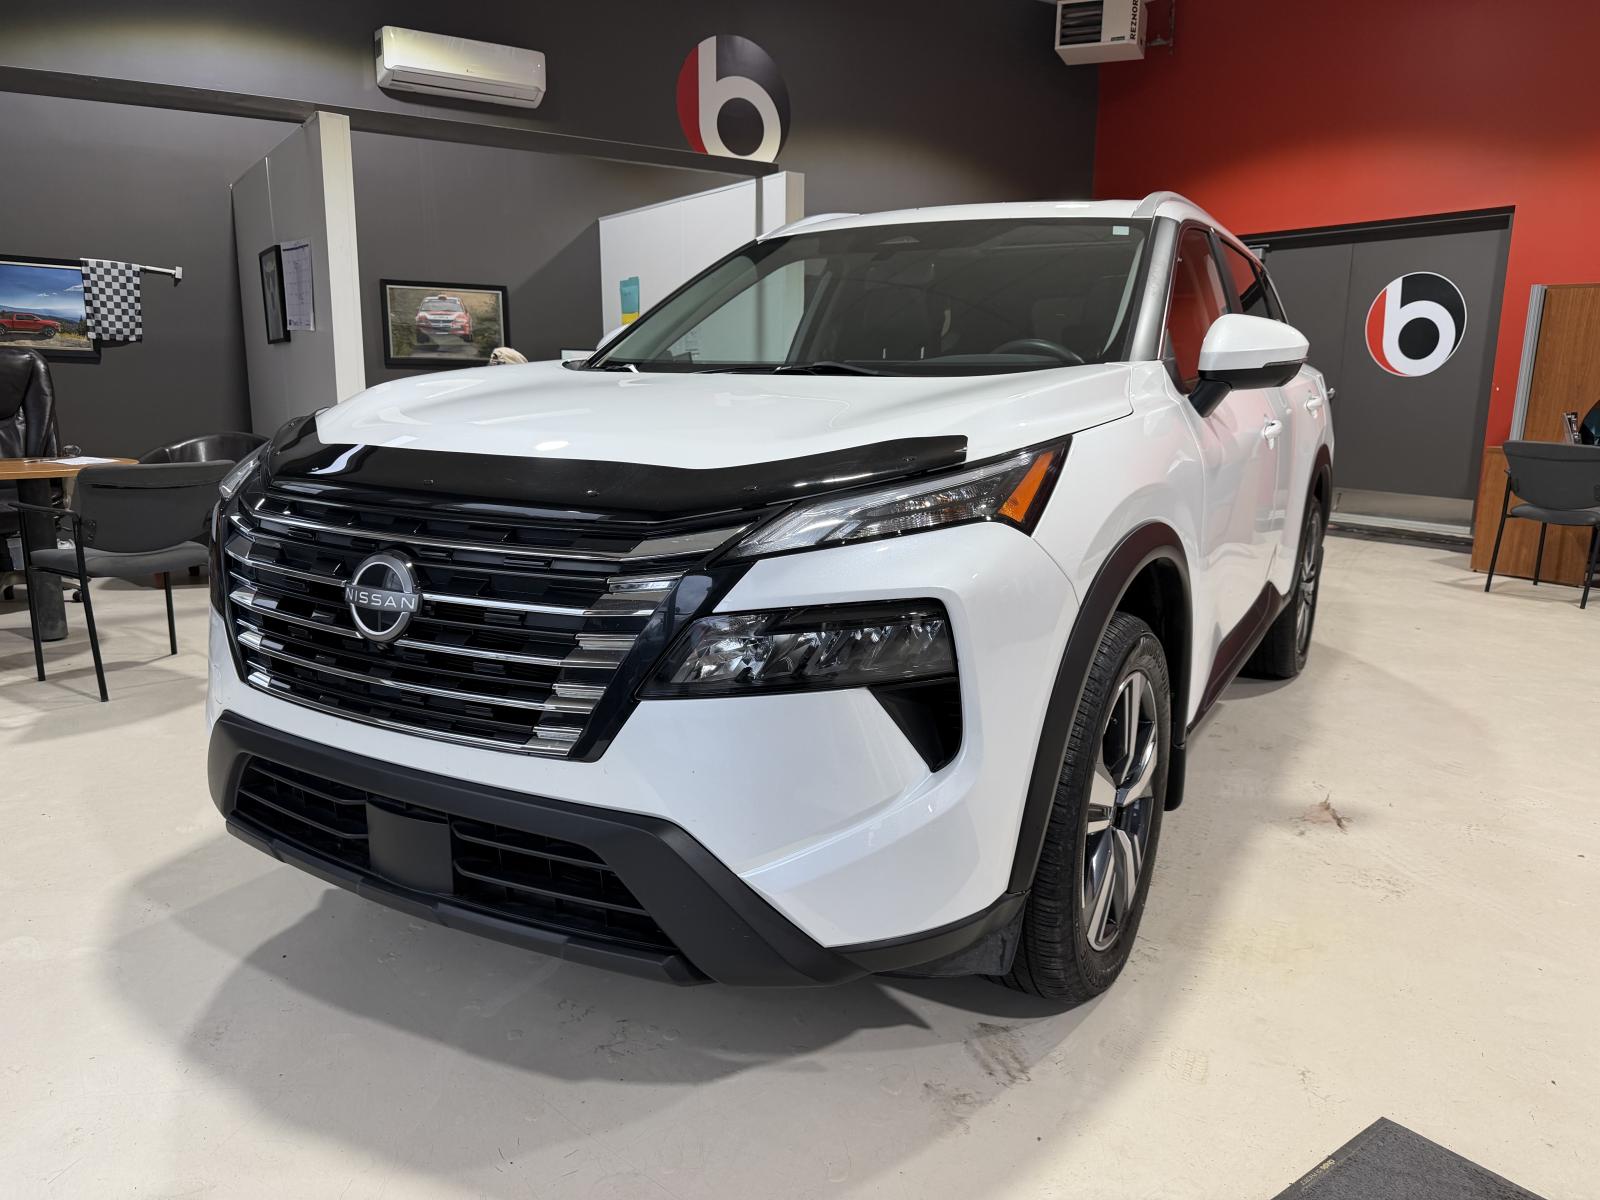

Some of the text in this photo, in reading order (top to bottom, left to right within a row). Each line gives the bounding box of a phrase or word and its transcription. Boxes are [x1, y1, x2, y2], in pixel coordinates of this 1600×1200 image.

[1129, 0, 1139, 40] REZNOR
[697, 35, 782, 163] b
[1382, 276, 1456, 377] b
[345, 587, 415, 610] NISSAN
